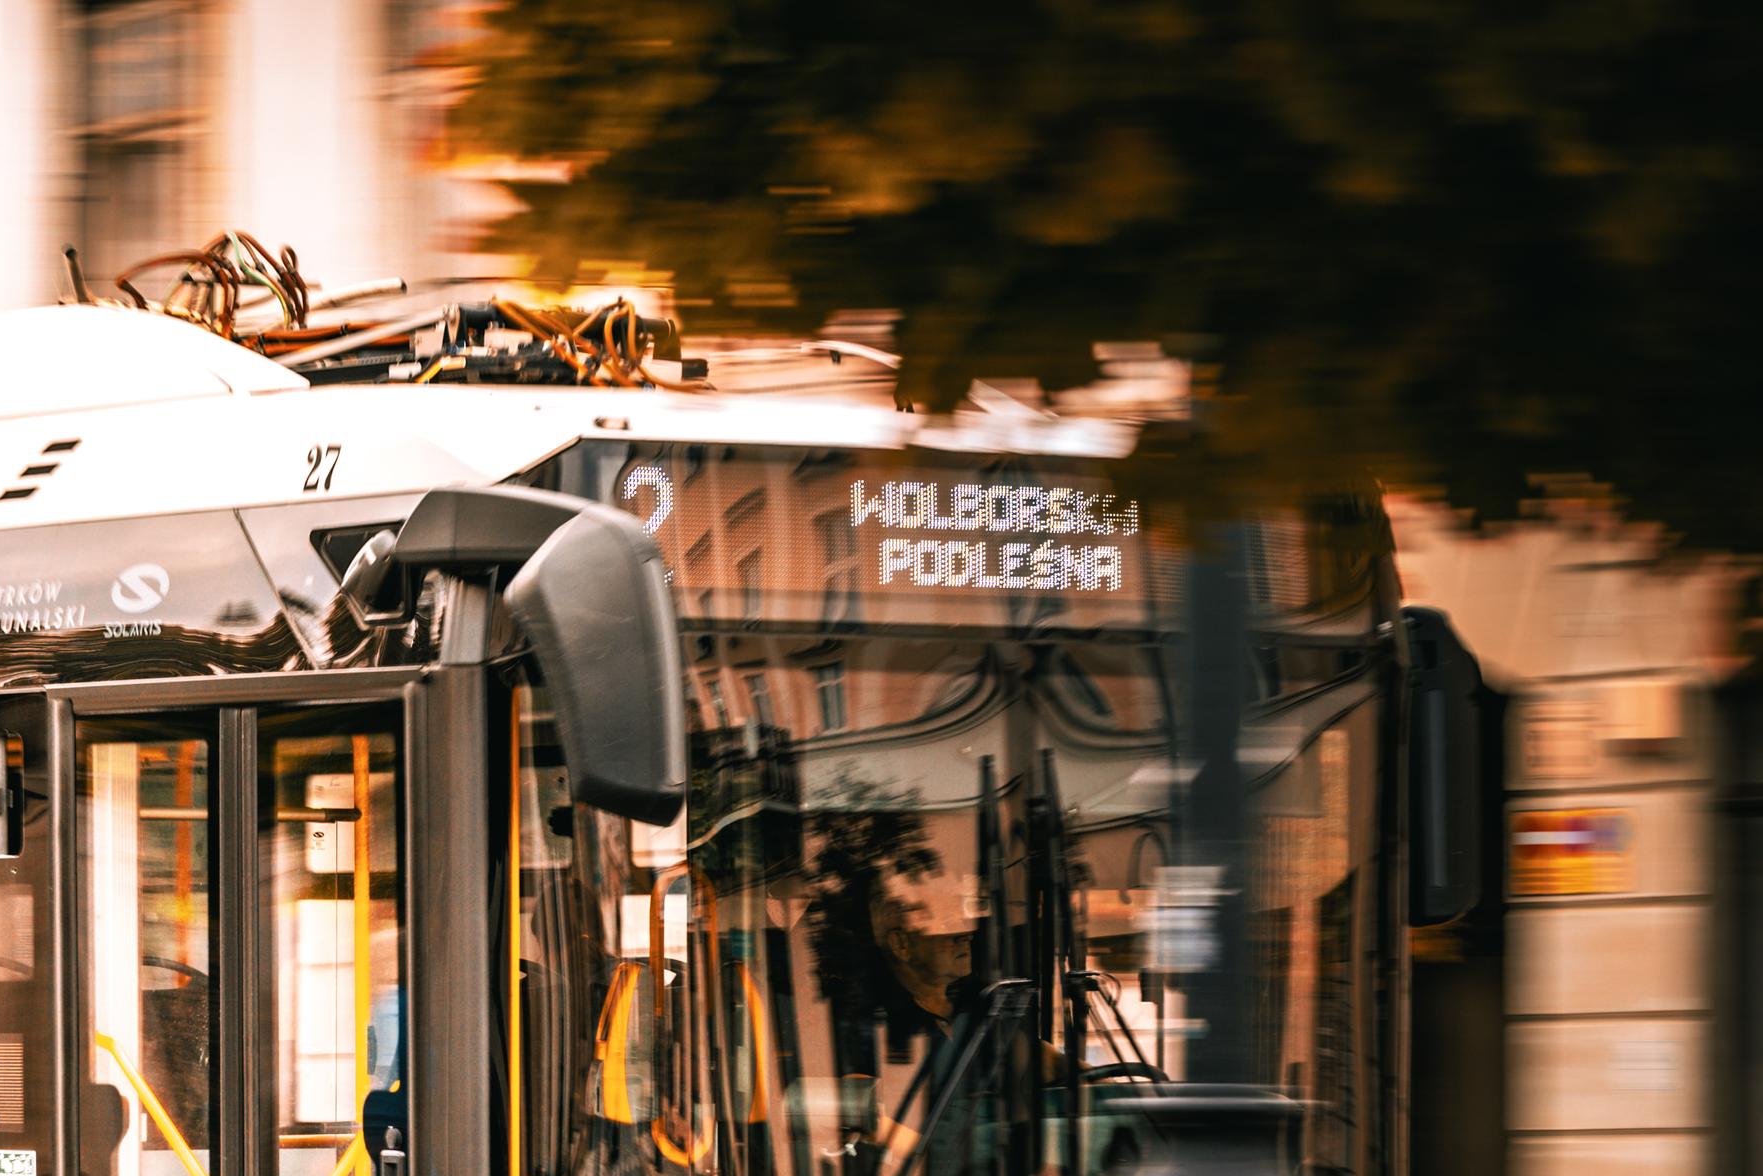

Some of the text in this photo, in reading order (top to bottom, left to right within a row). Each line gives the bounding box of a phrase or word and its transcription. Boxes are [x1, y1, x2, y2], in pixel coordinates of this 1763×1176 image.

[302, 444, 342, 493] 27
[879, 539, 1122, 592] PODLEŚNA
[102, 619, 162, 639] SOLARIS
